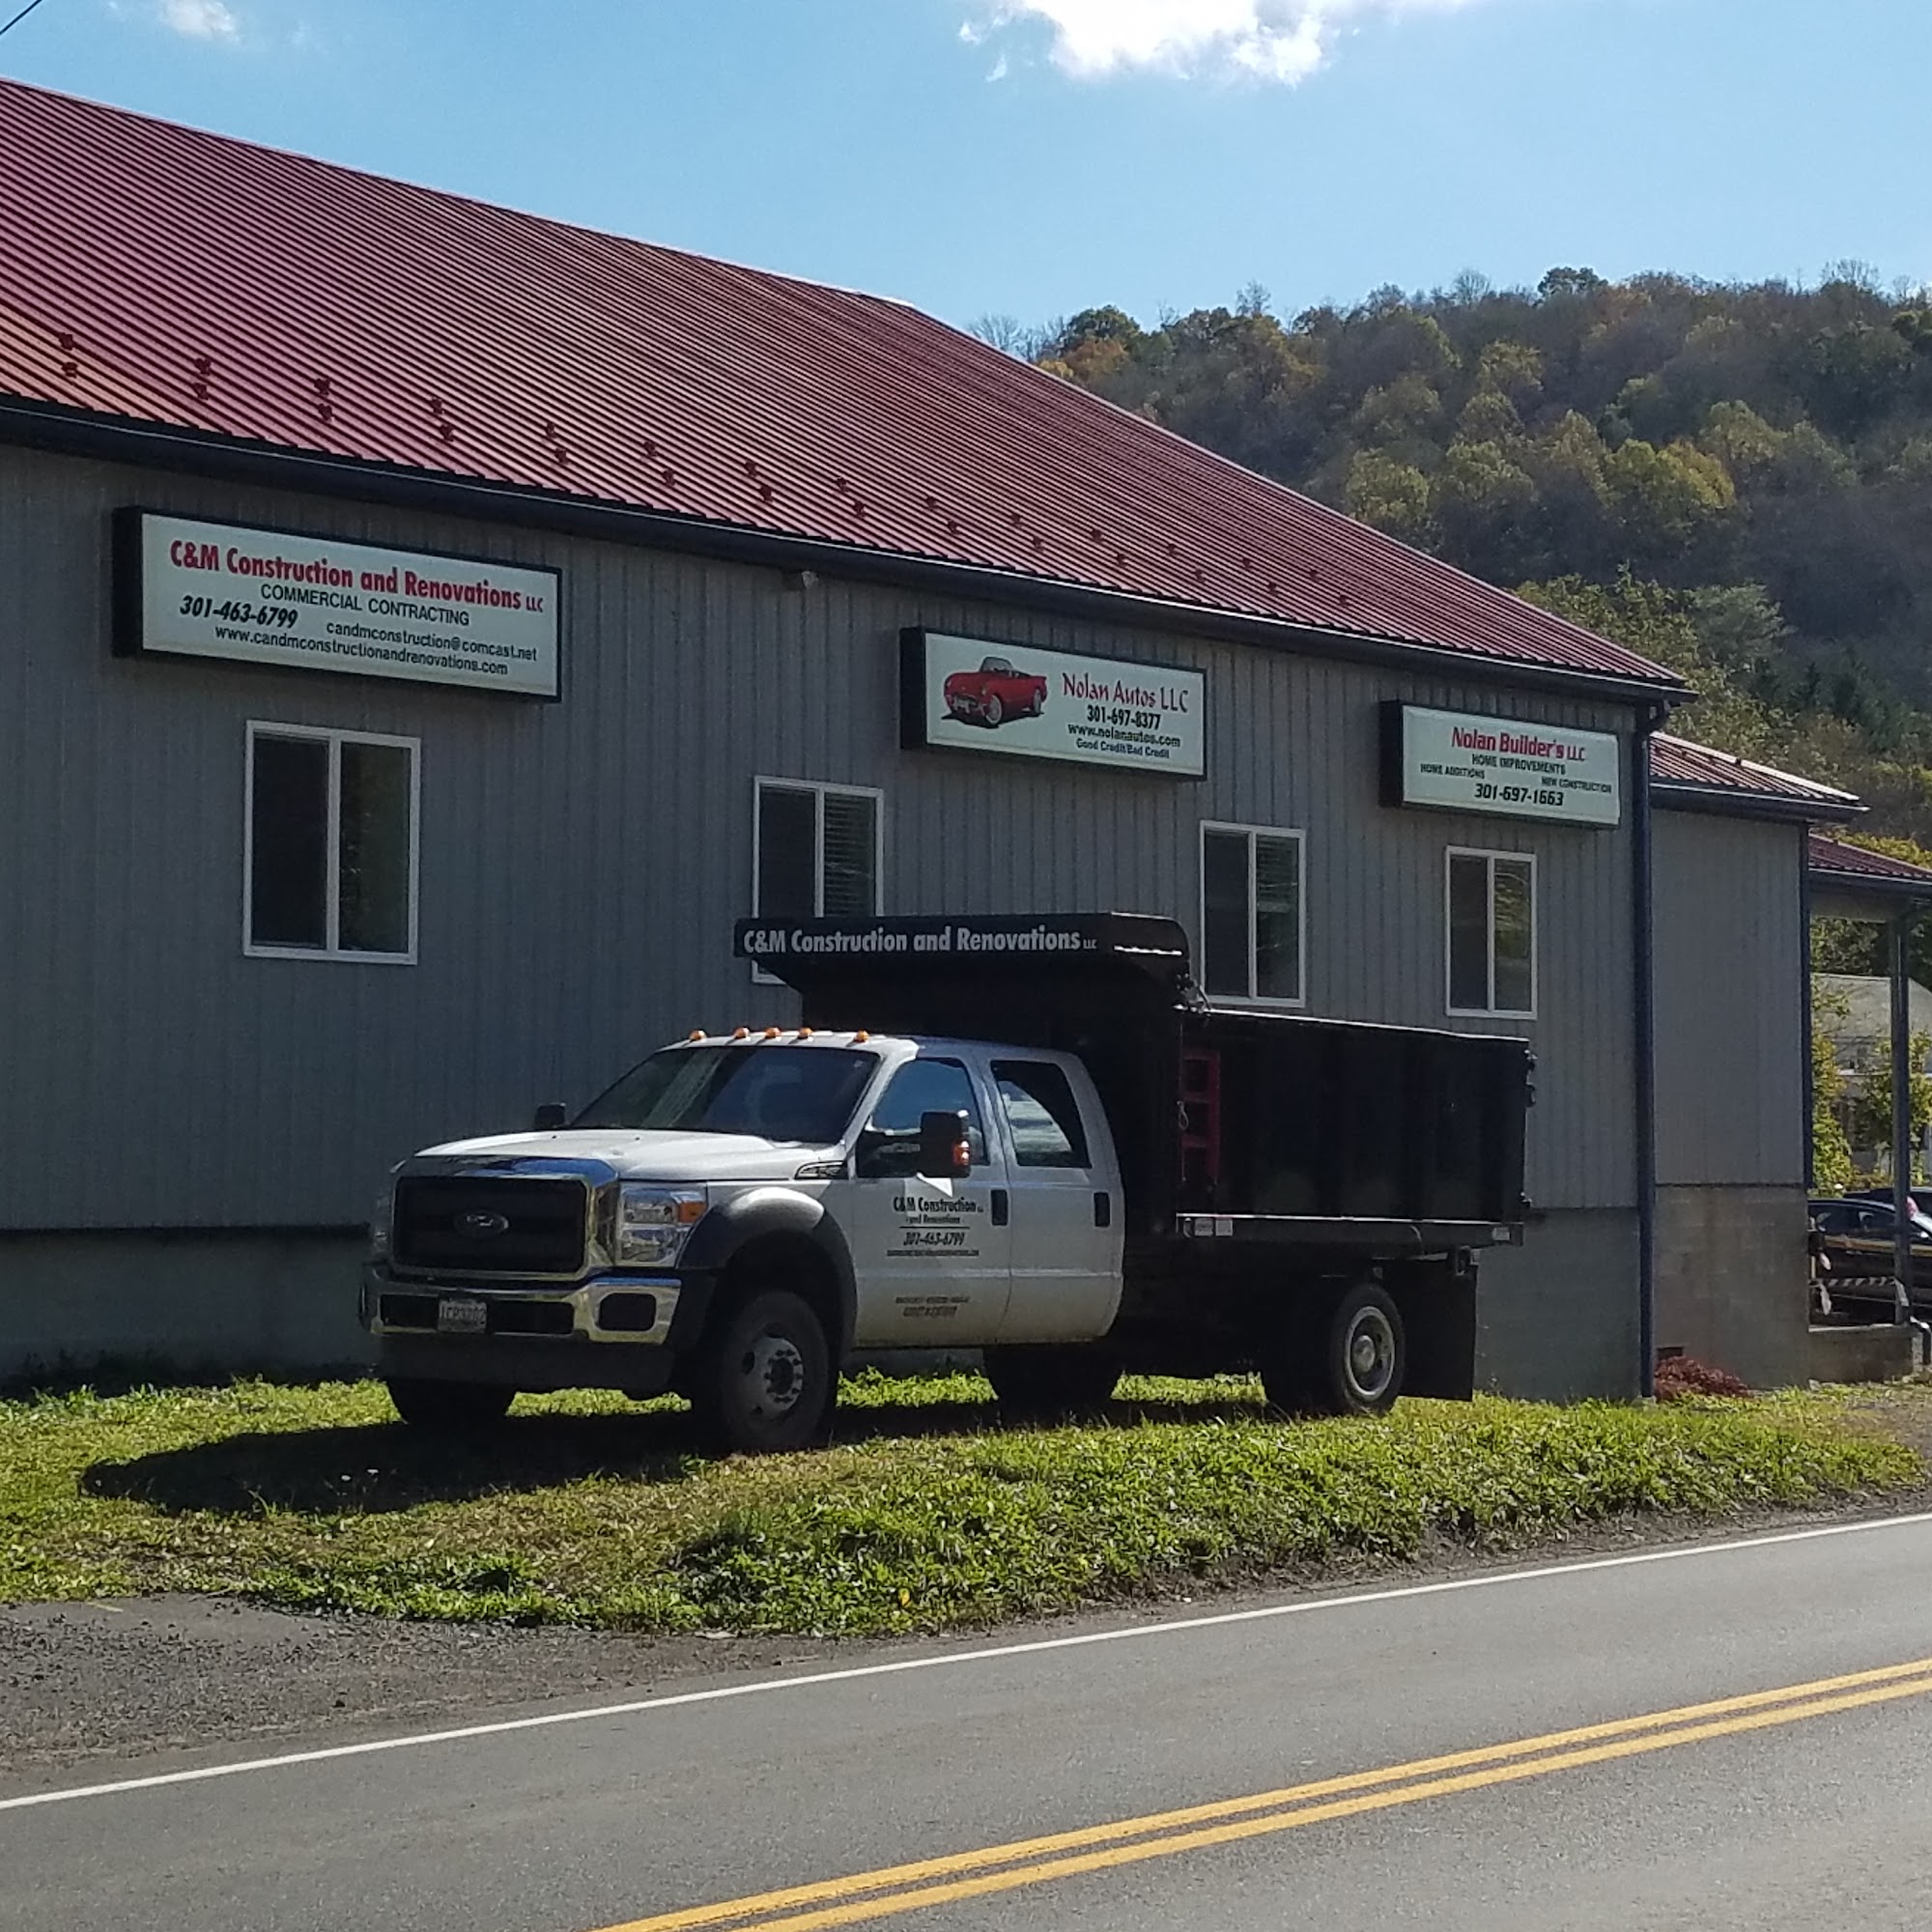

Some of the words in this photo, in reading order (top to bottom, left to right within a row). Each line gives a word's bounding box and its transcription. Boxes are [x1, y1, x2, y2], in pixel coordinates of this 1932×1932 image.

[170, 540, 219, 572] C&M
[226, 547, 353, 588] Construction
[360, 567, 398, 595] and
[405, 571, 522, 611] Renovations
[526, 596, 544, 613] LLC
[180, 595, 298, 629] 301-463-6799
[260, 582, 363, 612] COMMERCIAL
[367, 598, 470, 627] CONTRACTING
[214, 626, 509, 675] www.candmconstructionandrenovations.com
[326, 621, 538, 663] candmconstruction@comcast.net
[1062, 672, 1109, 701] Nolan
[1113, 679, 1157, 708] Autos
[1160, 686, 1189, 713] LLC
[1087, 704, 1161, 730] 301-697-8377
[1067, 724, 1181, 748] www.nolanautos.com
[1452, 726, 1496, 753] Nolan
[1499, 732, 1565, 760] Builder's
[1567, 746, 1586, 762] LLC
[1420, 763, 1443, 775] HOME
[1444, 766, 1486, 781] ADDITIONS
[1471, 753, 1497, 768] HOME
[1499, 757, 1567, 776] IMPROVEMENTS
[1474, 782, 1565, 807] 301-697-1663
[1541, 776, 1557, 787] NEW
[1558, 779, 1612, 794] CONSTRUCTION
[743, 929, 785, 953] C&M
[791, 926, 907, 952] Construction
[913, 924, 951, 951] and
[956, 923, 1081, 951] Renovations
[918, 1196, 977, 1213] Construction
